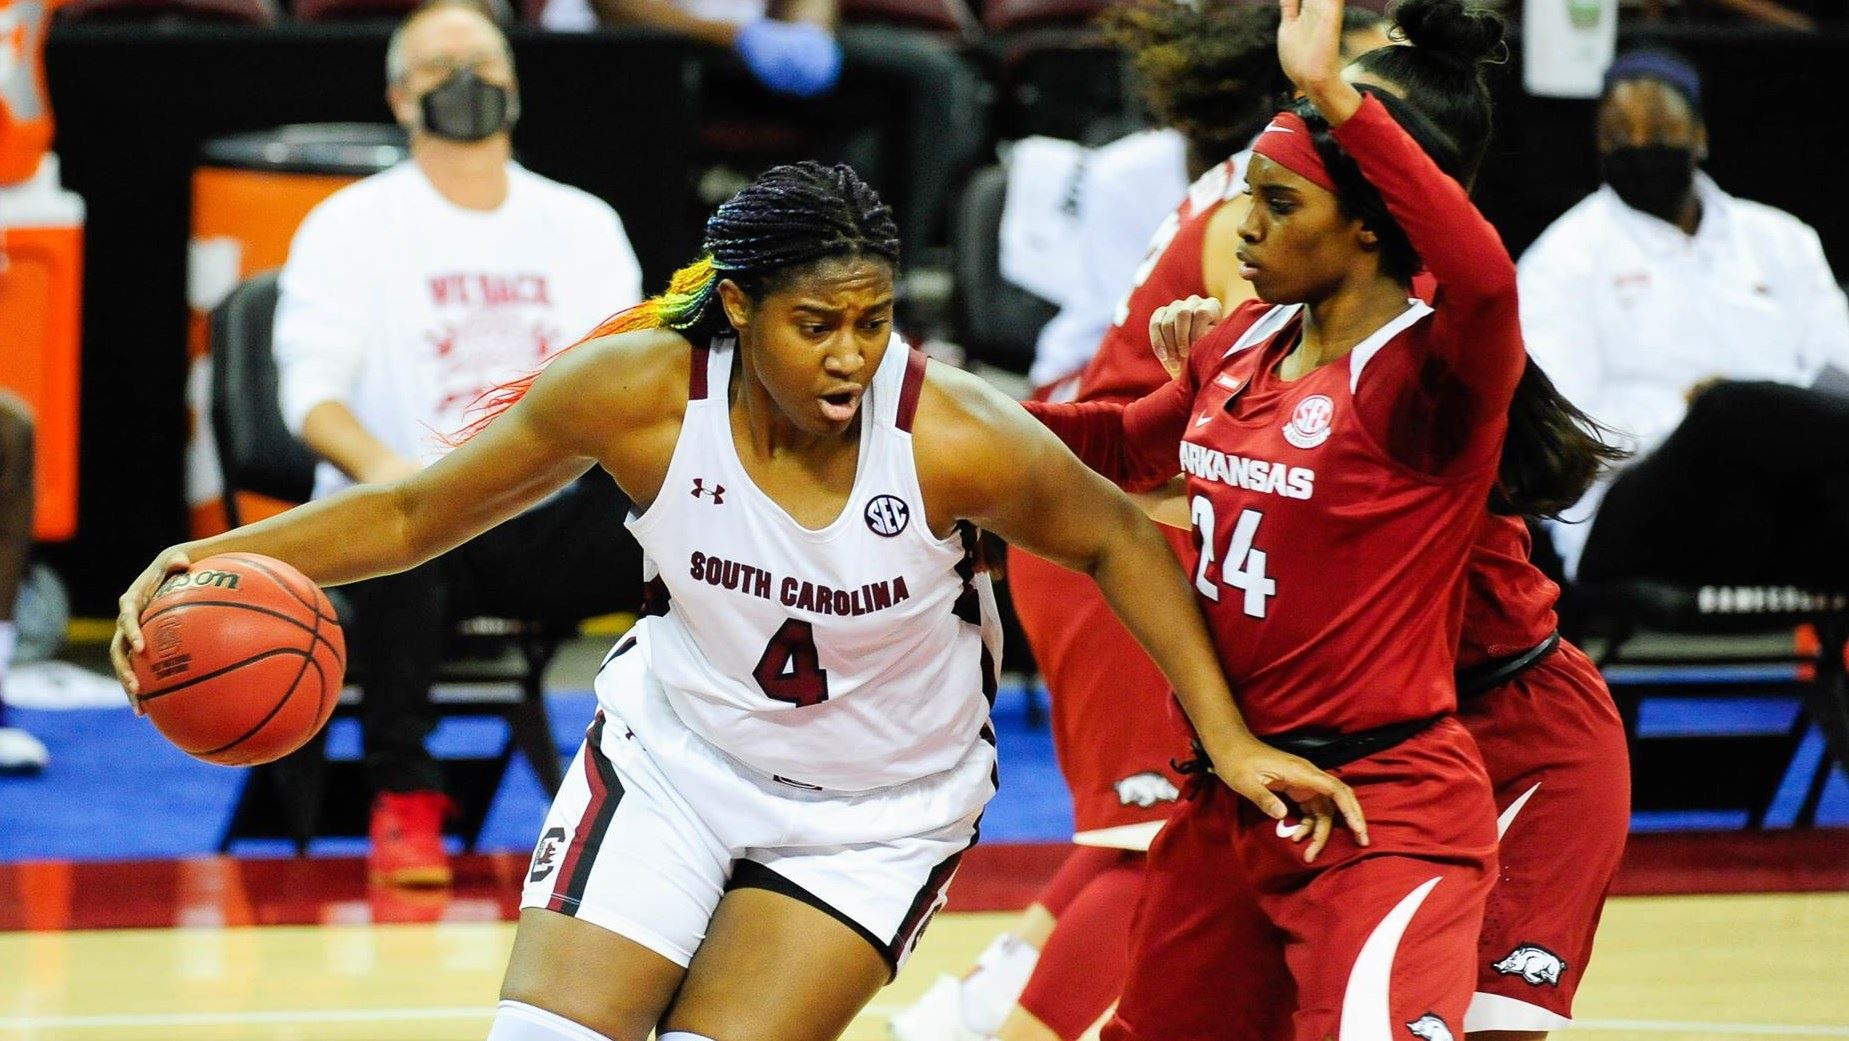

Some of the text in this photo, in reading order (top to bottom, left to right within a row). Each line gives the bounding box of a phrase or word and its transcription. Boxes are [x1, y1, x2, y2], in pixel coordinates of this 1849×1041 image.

[1294, 397, 1333, 433] SEC
[1179, 440, 1315, 500] ARKANSAS
[867, 497, 907, 535] SEC
[154, 570, 240, 598] son
[690, 551, 910, 617] SOUTH CAROLINA
[1191, 495, 1276, 618] 24
[752, 617, 829, 708] 4
